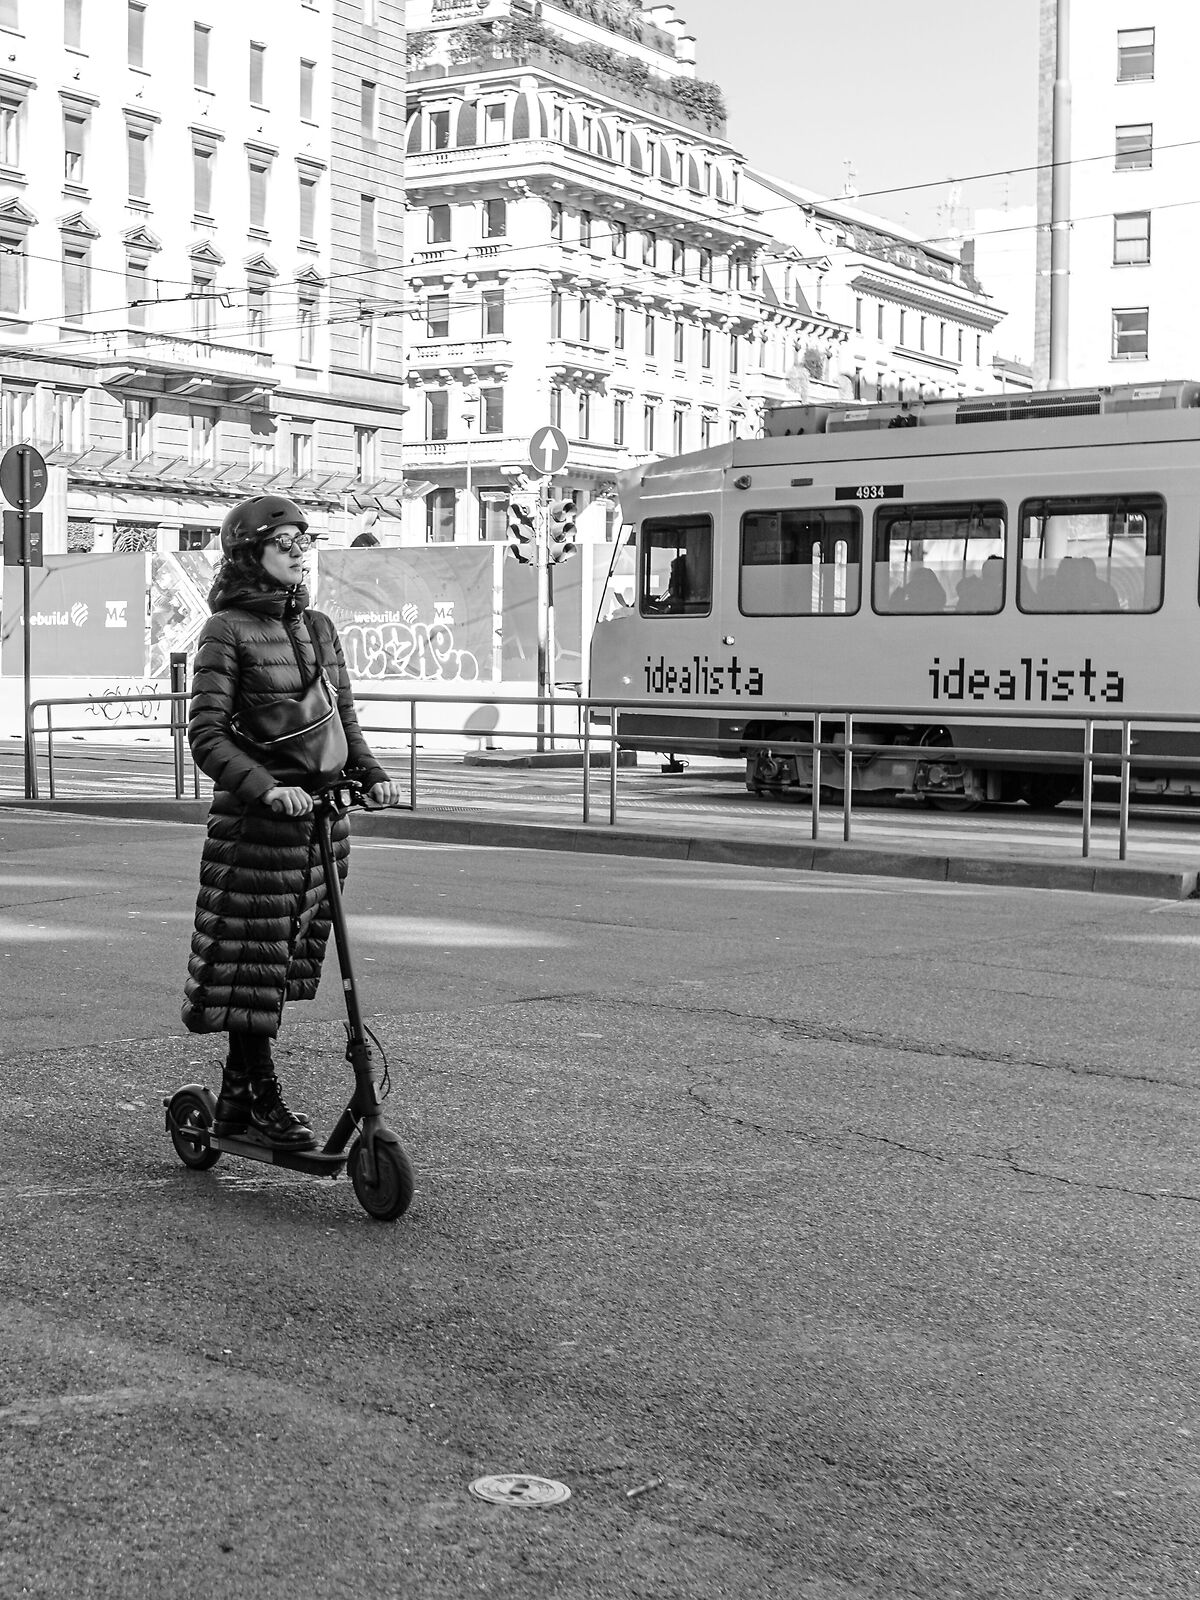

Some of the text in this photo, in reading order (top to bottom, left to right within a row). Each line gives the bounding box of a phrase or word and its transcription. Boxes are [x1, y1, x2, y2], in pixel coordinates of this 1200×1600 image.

[856, 486, 884, 498] 4934
[105, 605, 127, 624] M4
[354, 611, 400, 622] webuild
[645, 656, 763, 695] idealista
[929, 657, 1124, 702] idealista
